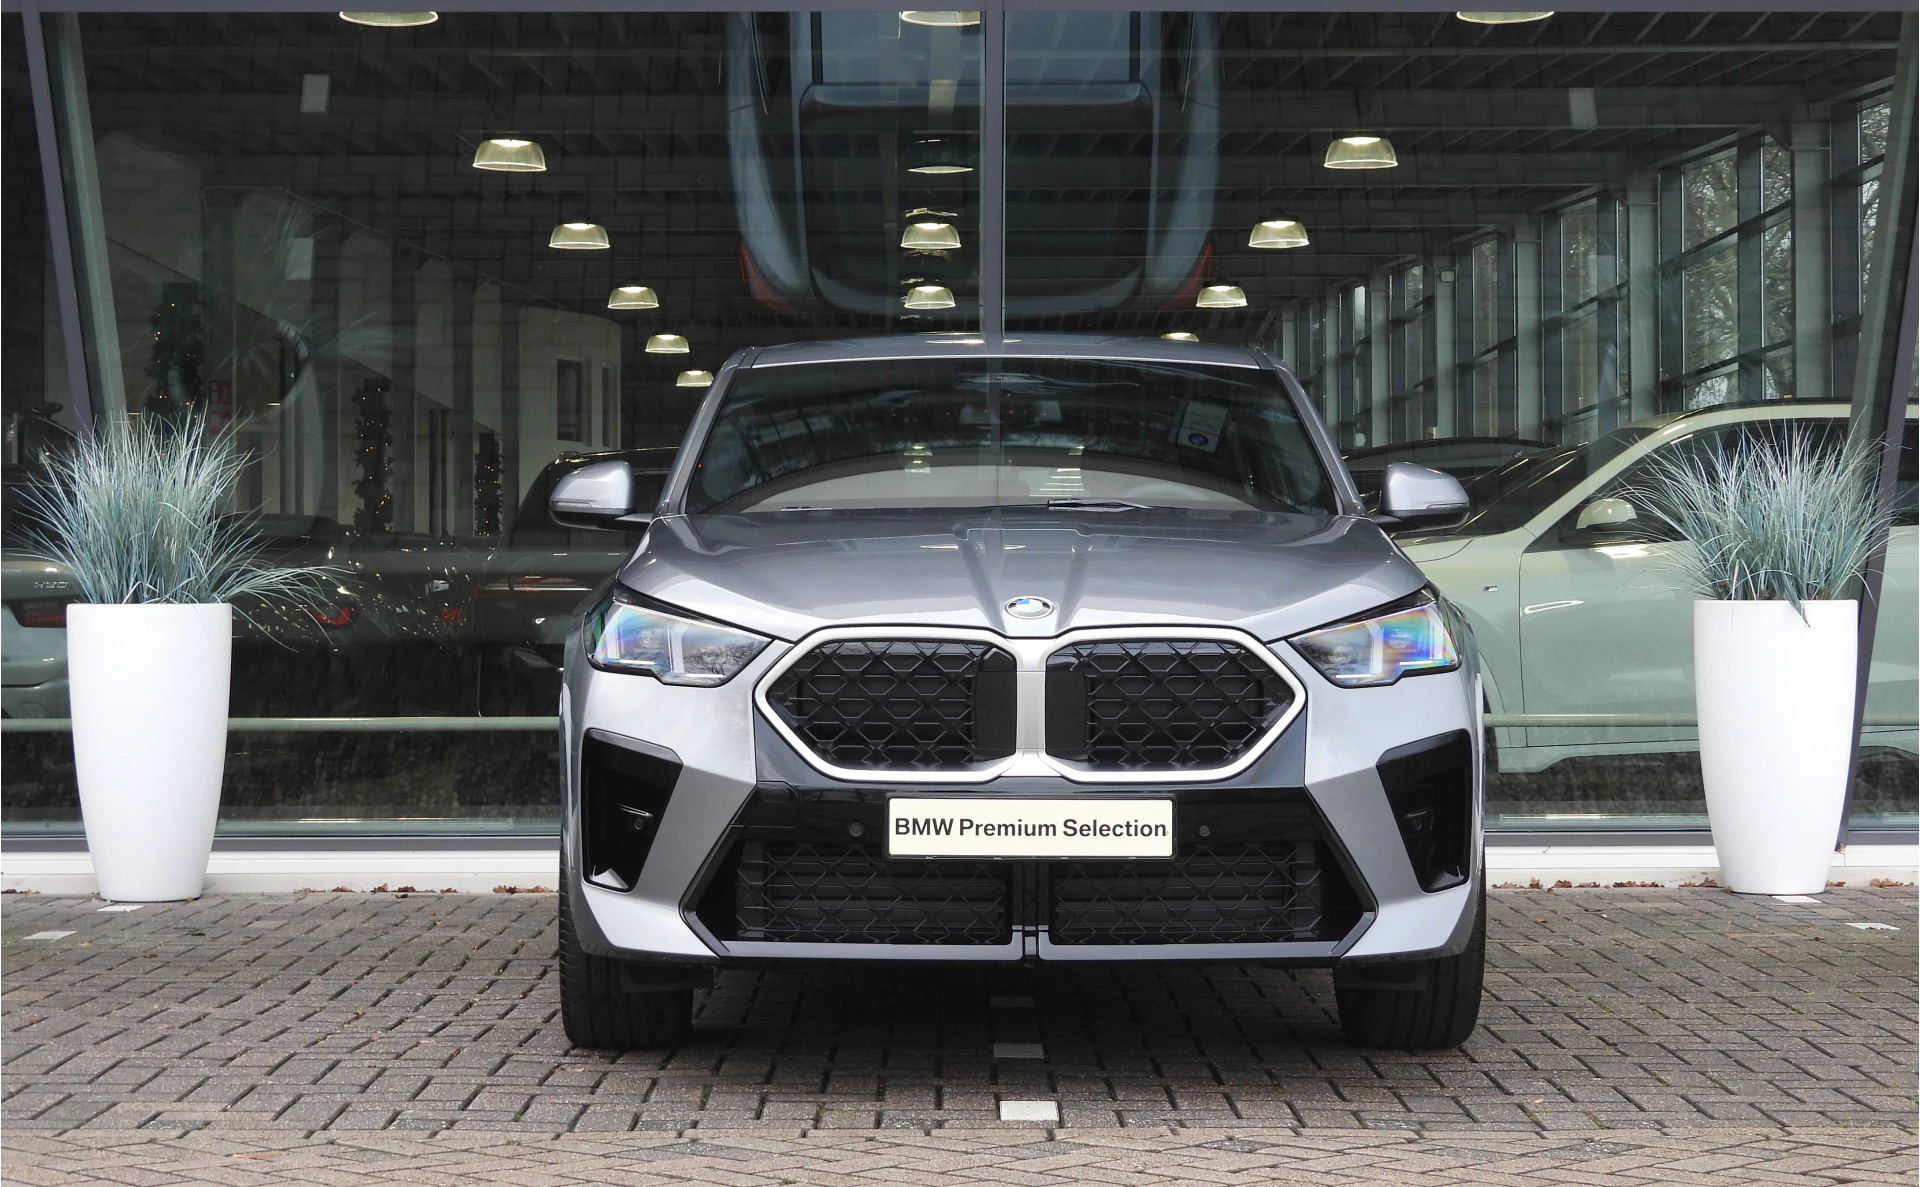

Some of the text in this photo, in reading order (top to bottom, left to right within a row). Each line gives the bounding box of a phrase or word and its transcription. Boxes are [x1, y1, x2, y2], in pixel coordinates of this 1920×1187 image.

[895, 817, 1167, 837] BMW Premium Selection
